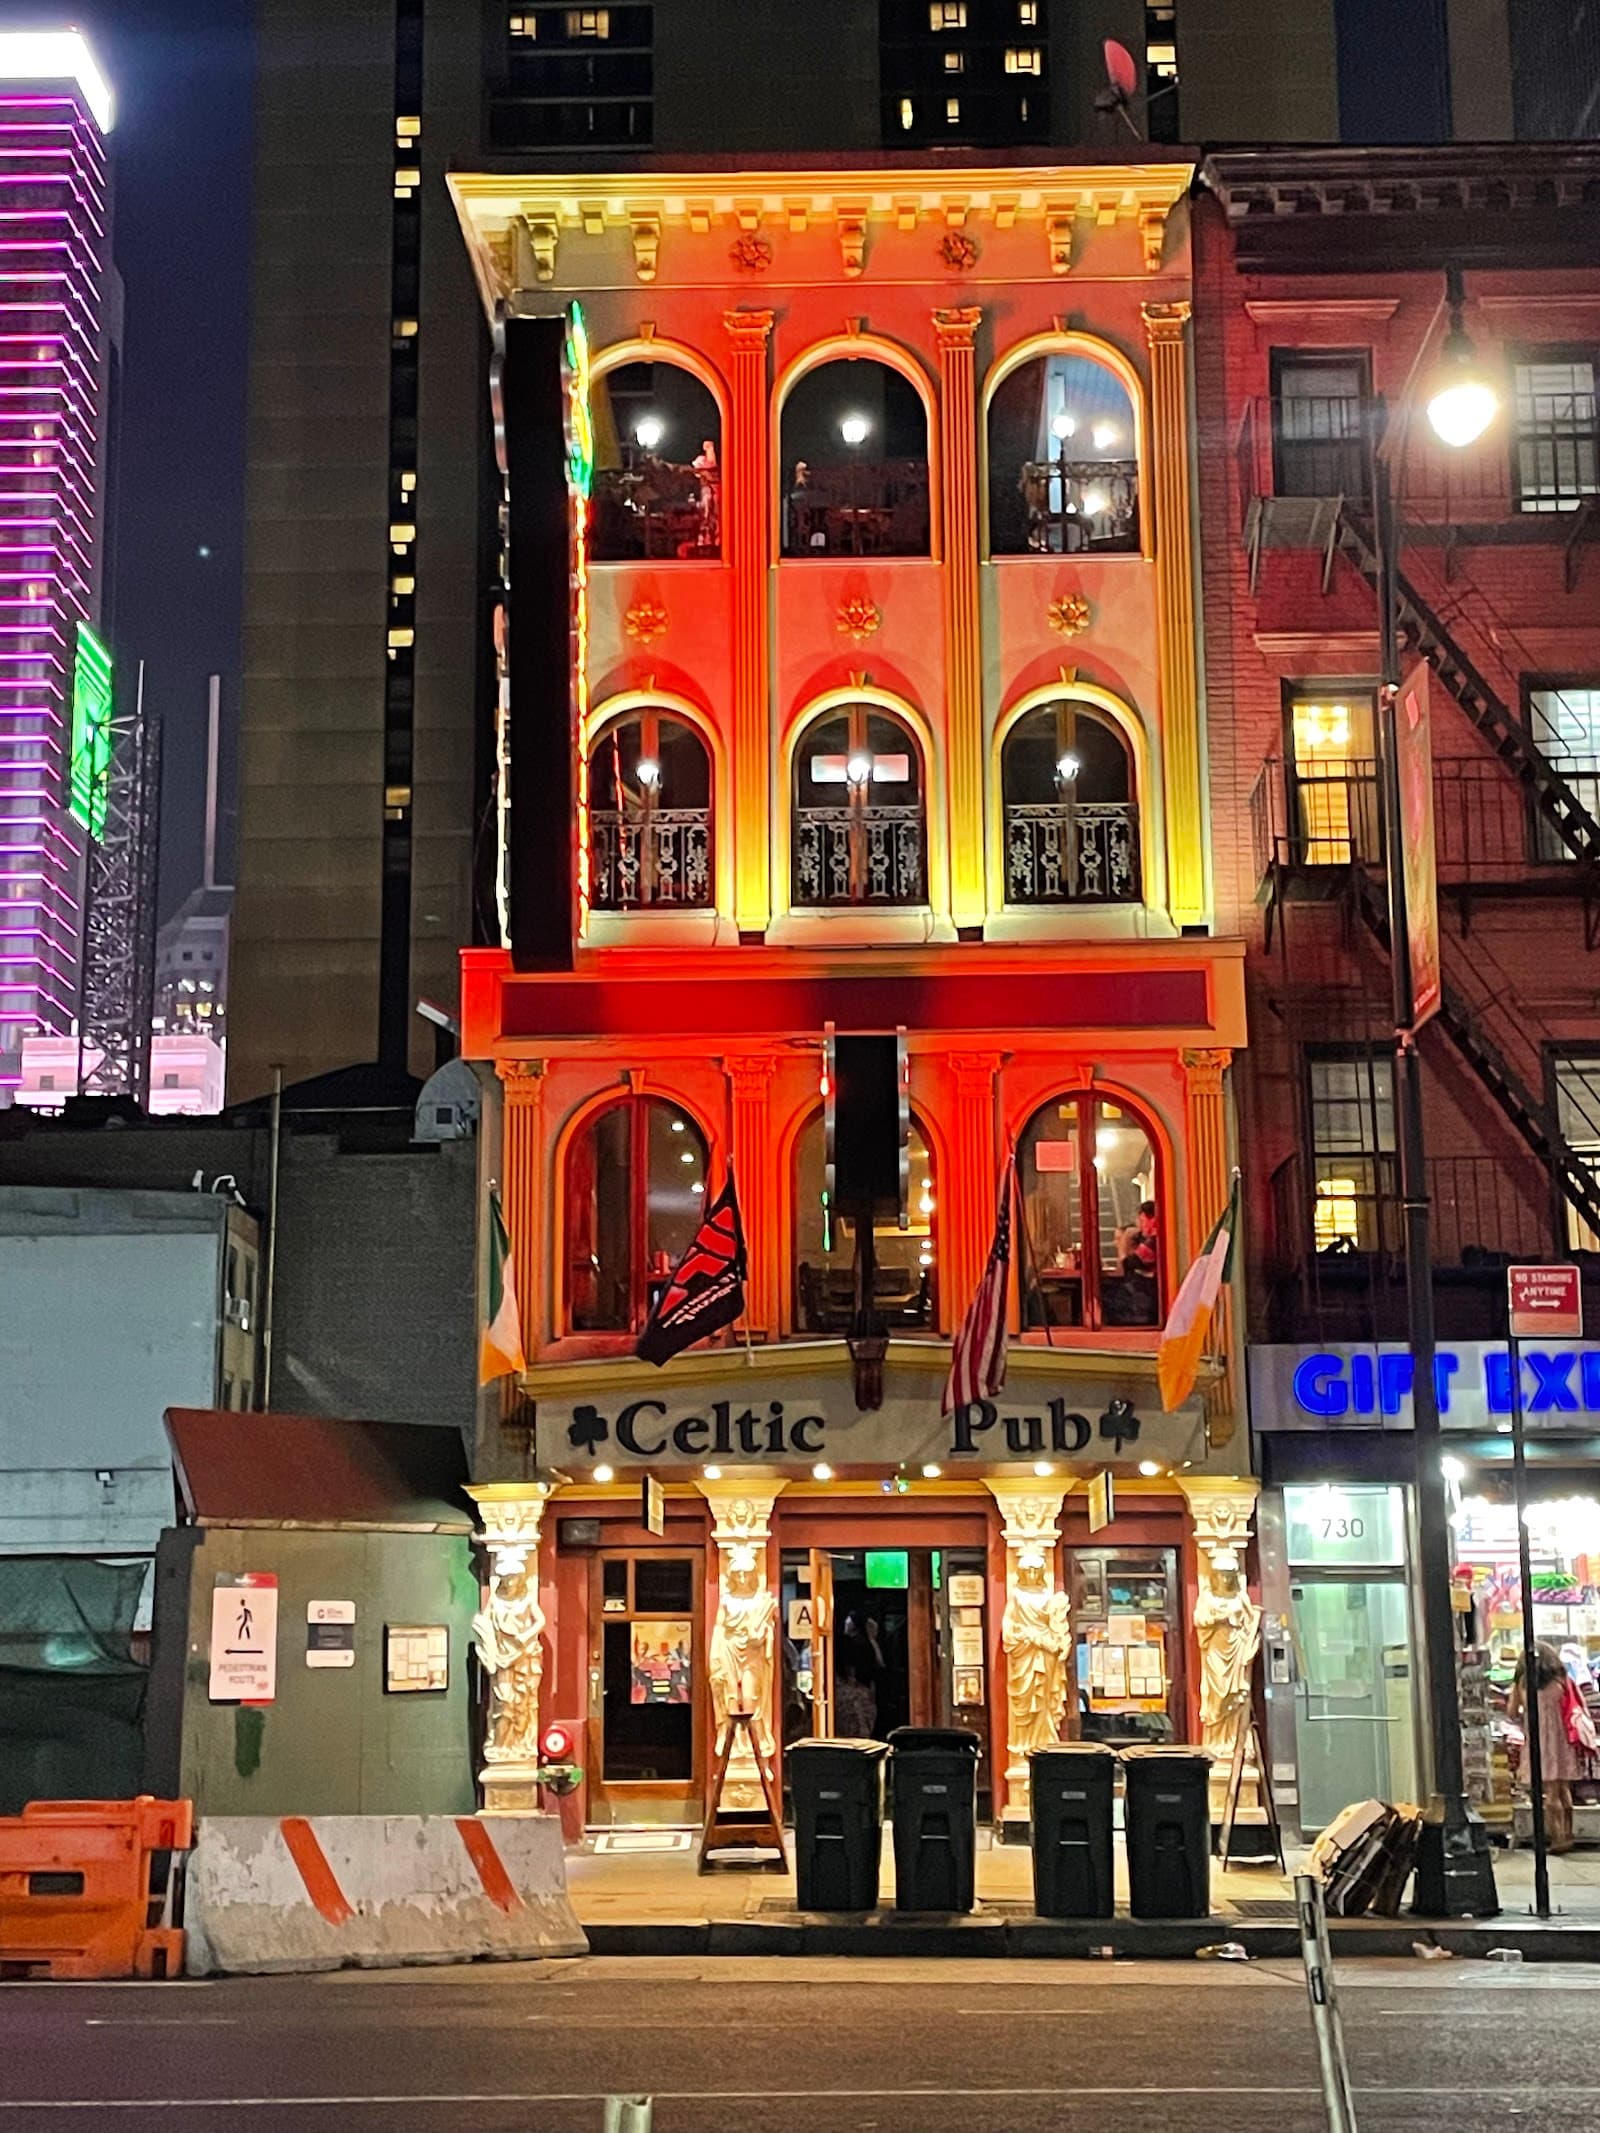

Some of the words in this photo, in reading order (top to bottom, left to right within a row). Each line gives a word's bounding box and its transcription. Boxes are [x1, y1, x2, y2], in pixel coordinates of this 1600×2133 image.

[1515, 1273, 1528, 1283] NO
[1531, 1273, 1572, 1283] STANDING
[1524, 1286, 1566, 1296] ANYTIME
[1293, 1353, 1459, 1416] GIFT
[616, 1400, 825, 1456] Celtic
[949, 1397, 1092, 1454] Pub
[1321, 1518, 1364, 1538] 730
[797, 1606, 812, 1625] A
